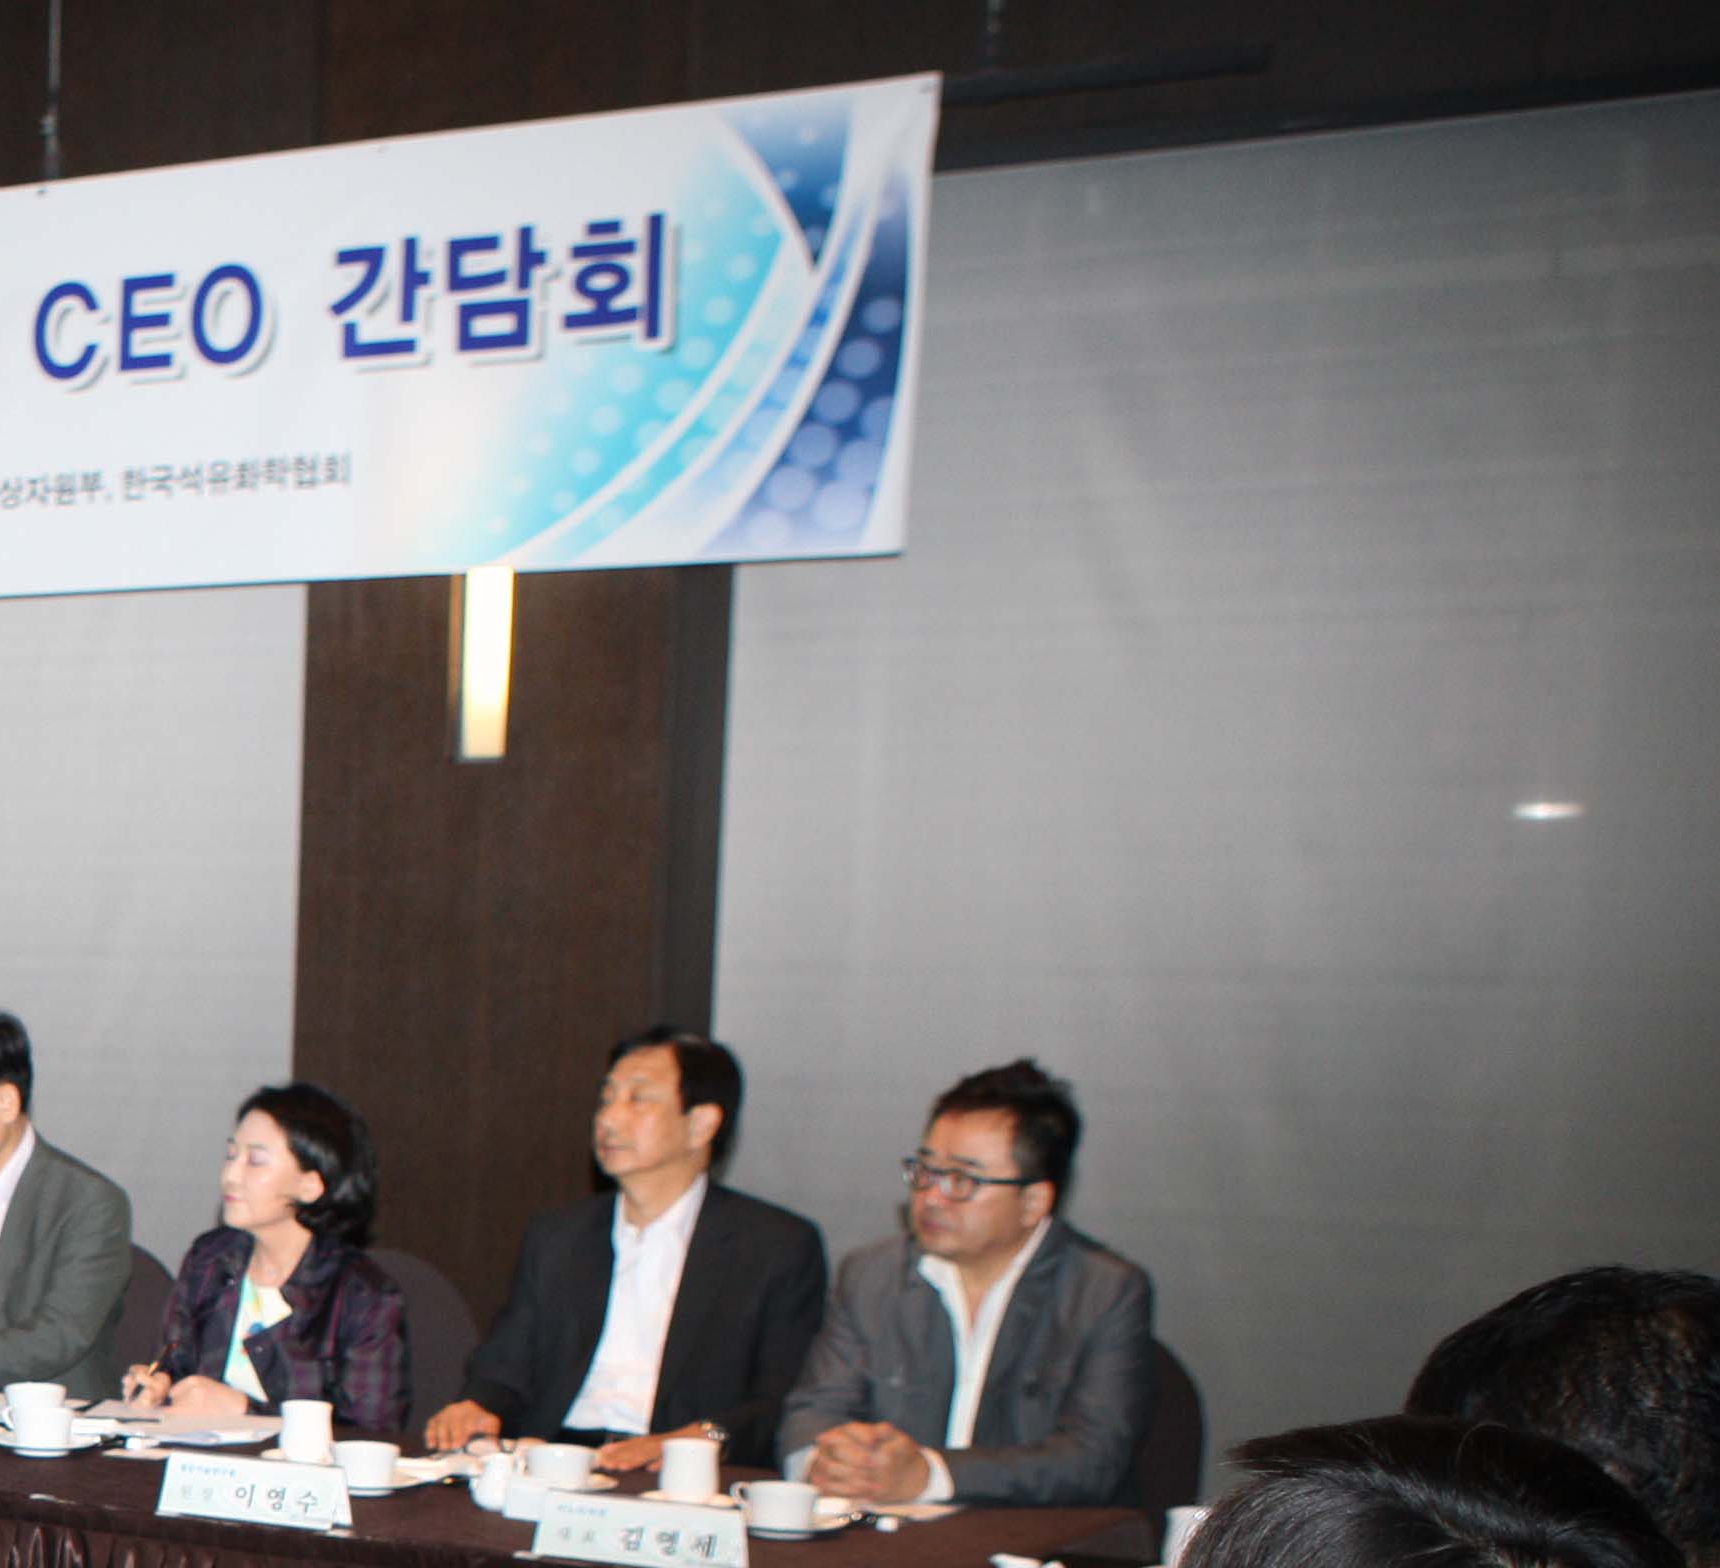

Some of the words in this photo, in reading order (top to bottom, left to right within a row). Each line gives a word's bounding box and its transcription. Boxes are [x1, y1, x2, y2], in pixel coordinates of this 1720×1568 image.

[33, 263, 263, 381] CEO
[327, 211, 667, 359] 간담회
[120, 449, 353, 503] 한국석유화학협회
